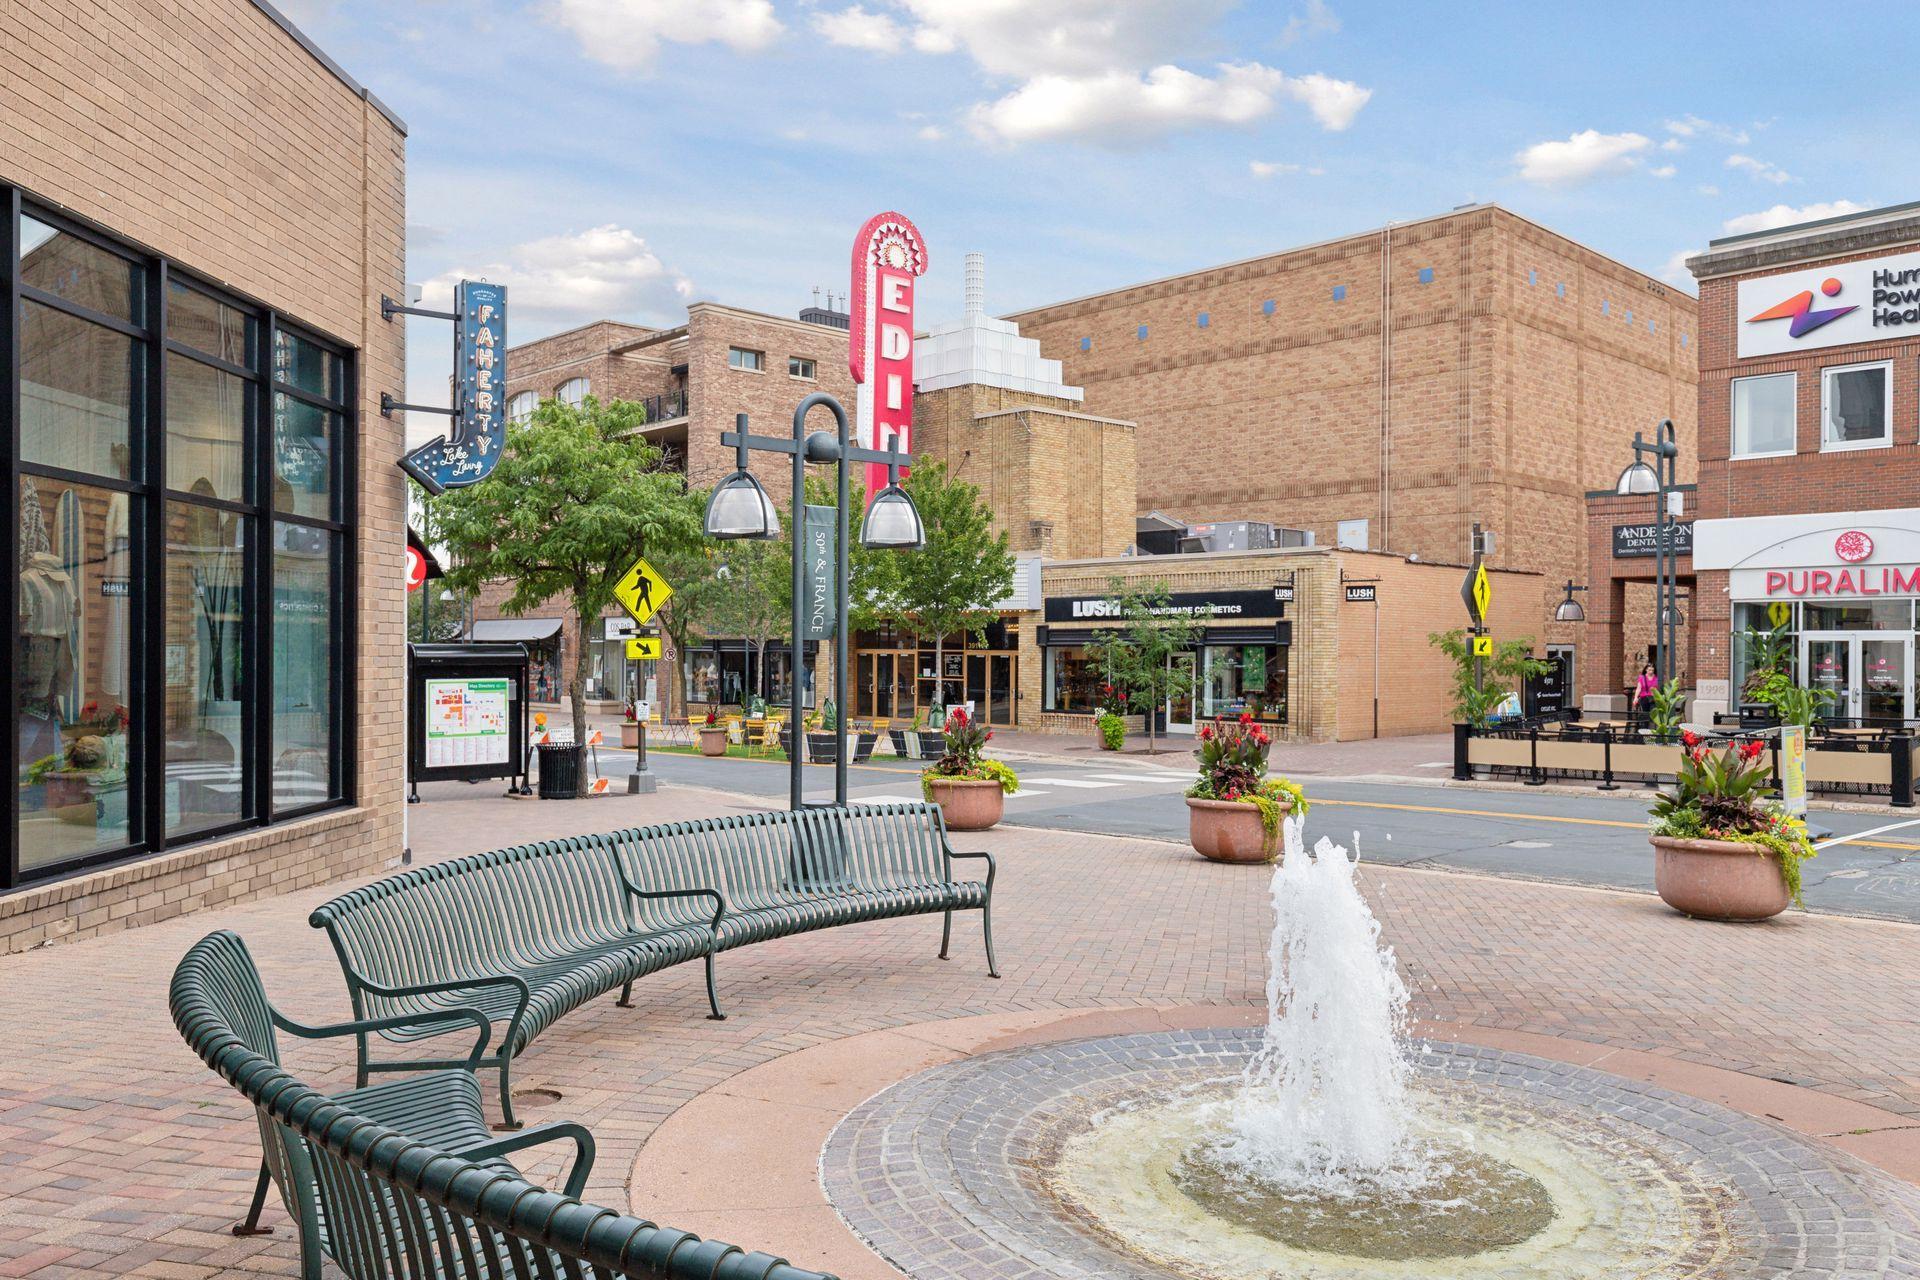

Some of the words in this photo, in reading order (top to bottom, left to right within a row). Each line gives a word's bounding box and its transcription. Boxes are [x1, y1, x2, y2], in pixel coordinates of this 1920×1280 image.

[476, 304, 494, 456] FAHERTY
[880, 273, 911, 488] EDIN
[440, 446, 468, 466] Lake
[815, 530, 826, 555] 50th
[1627, 538, 1657, 547] DENTA
[815, 558, 826, 574] &
[1274, 588, 1293, 598] LUSH
[1346, 588, 1374, 598] LUSH
[811, 576, 826, 632] FRANCE
